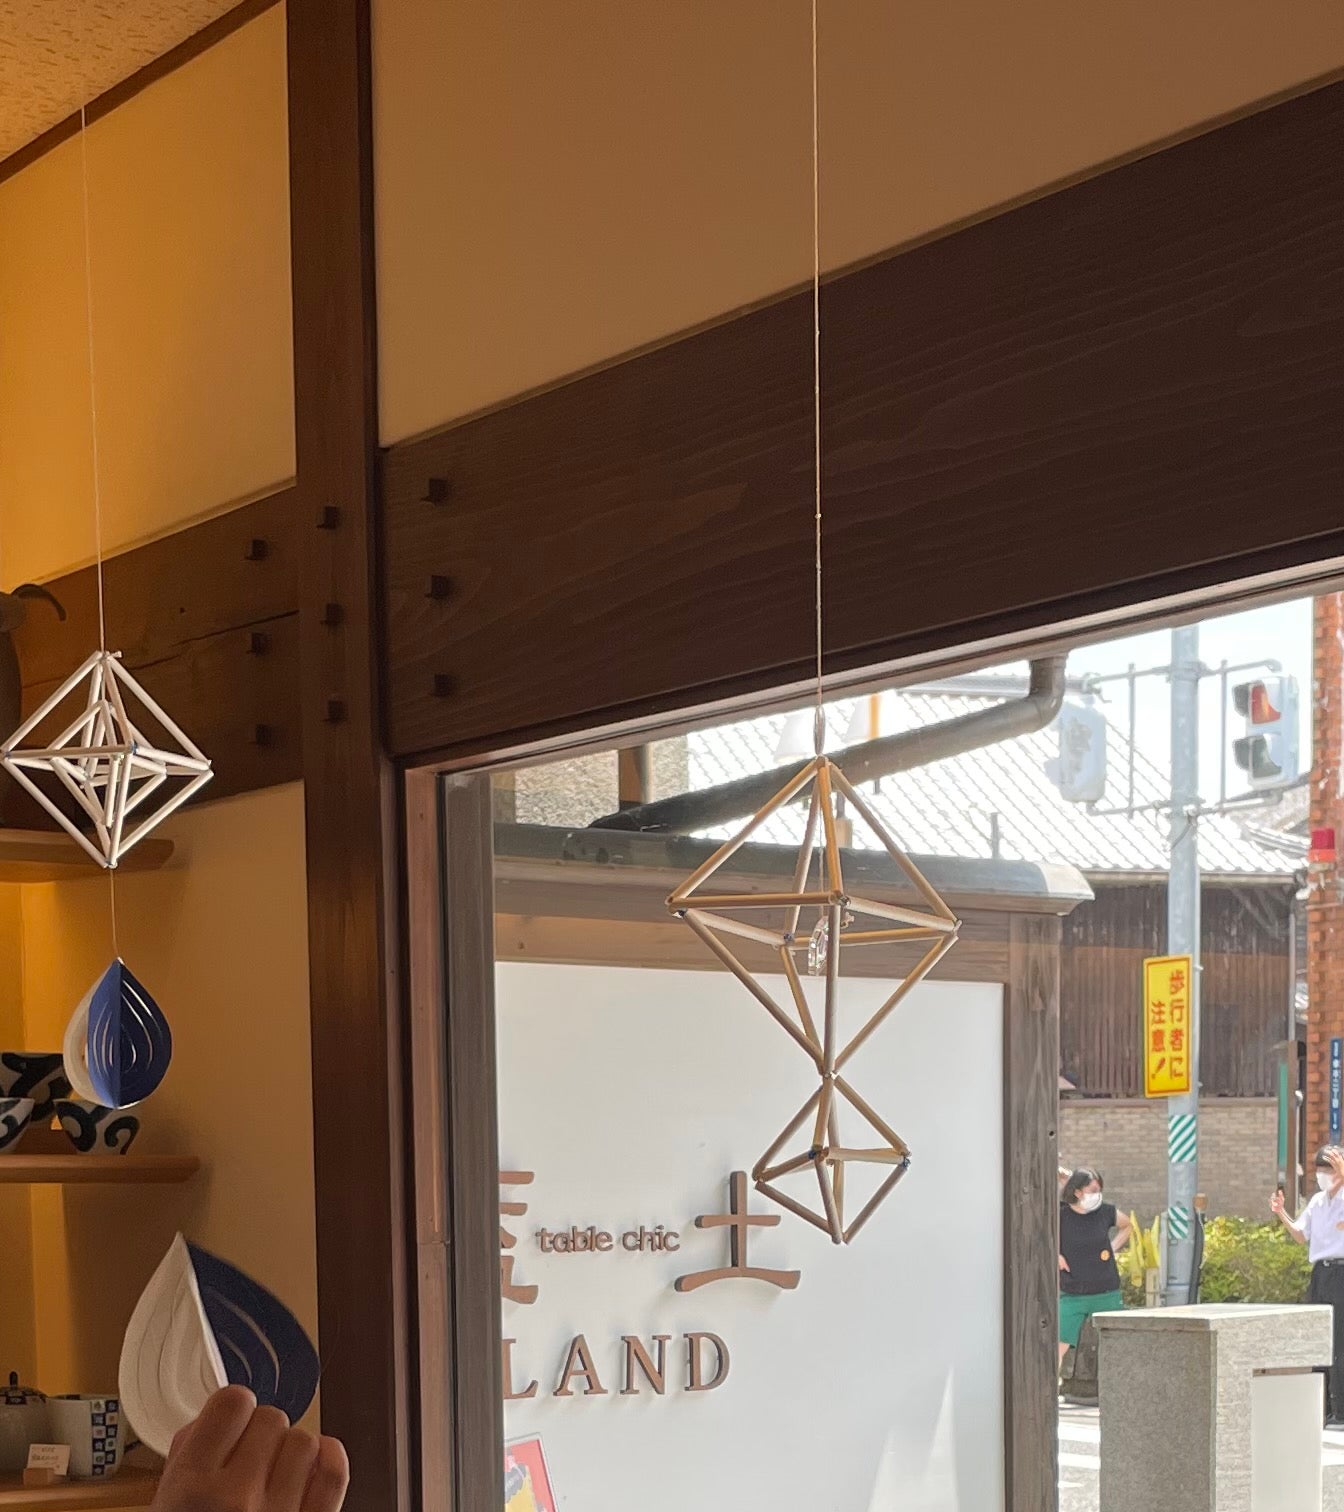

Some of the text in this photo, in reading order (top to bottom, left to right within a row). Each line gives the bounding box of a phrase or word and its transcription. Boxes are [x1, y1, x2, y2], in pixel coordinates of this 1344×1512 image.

[1169, 969, 1185, 1079] 歩行者に
[534, 1224, 682, 1254] table chic
[500, 1331, 732, 1401] LAND
